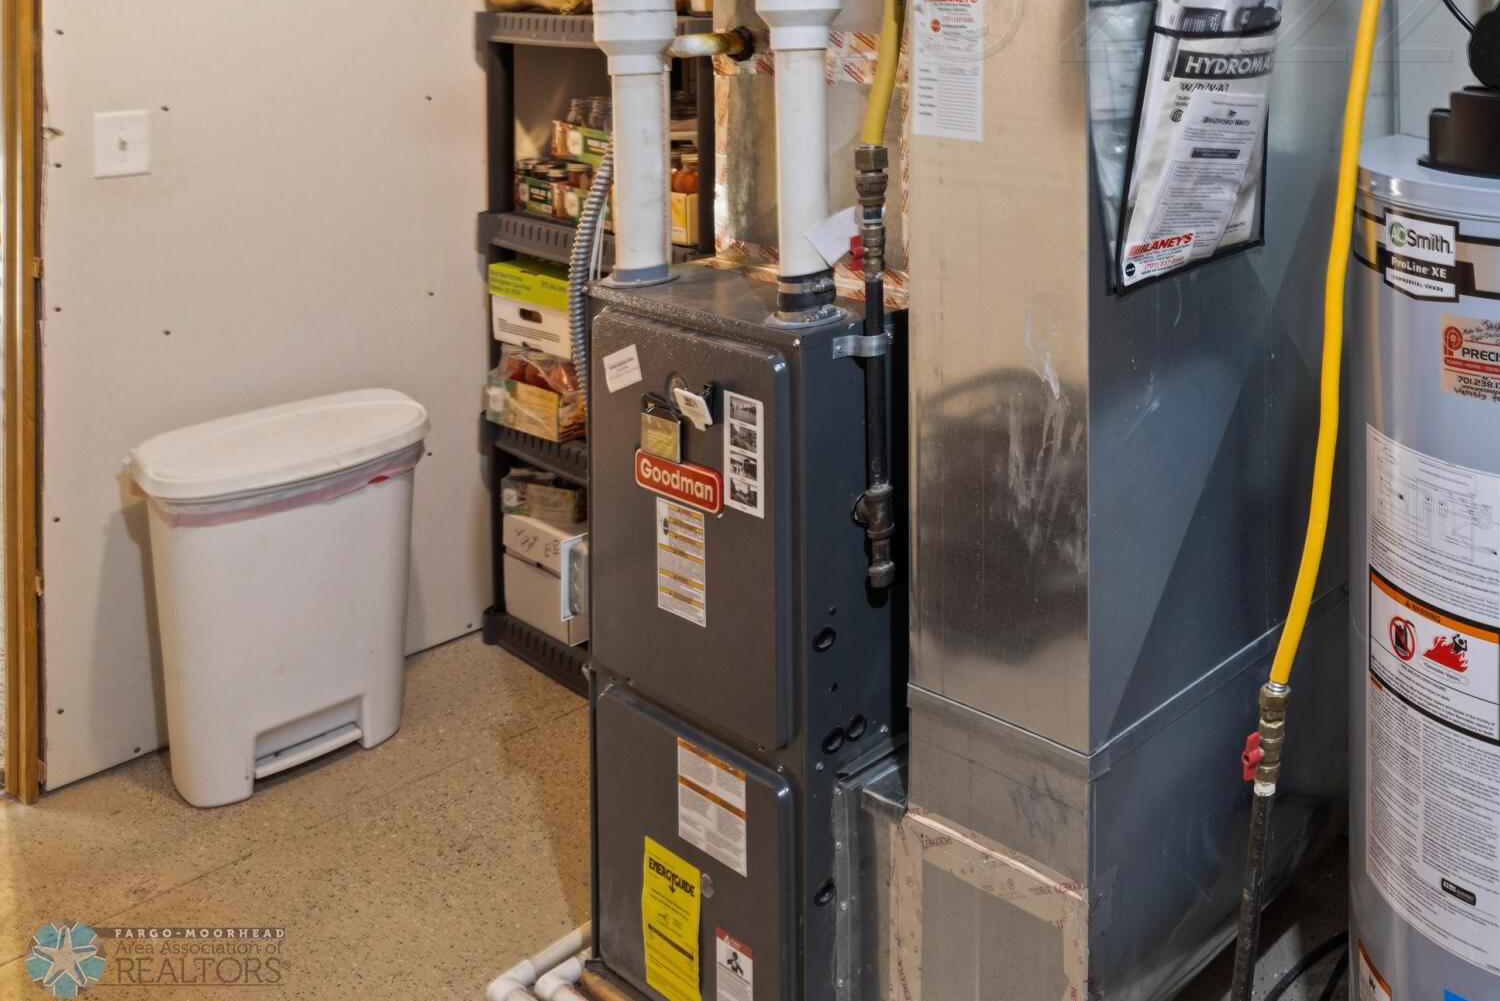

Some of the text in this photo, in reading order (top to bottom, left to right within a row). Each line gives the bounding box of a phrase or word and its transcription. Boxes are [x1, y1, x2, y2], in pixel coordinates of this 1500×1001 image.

[1407, 228, 1452, 254] Smith
[1391, 255, 1447, 279] ProLine XE
[640, 458, 714, 503] Goodman
[1411, 603, 1441, 623] WARNING
[648, 856, 695, 898] ENERGYGUIDE
